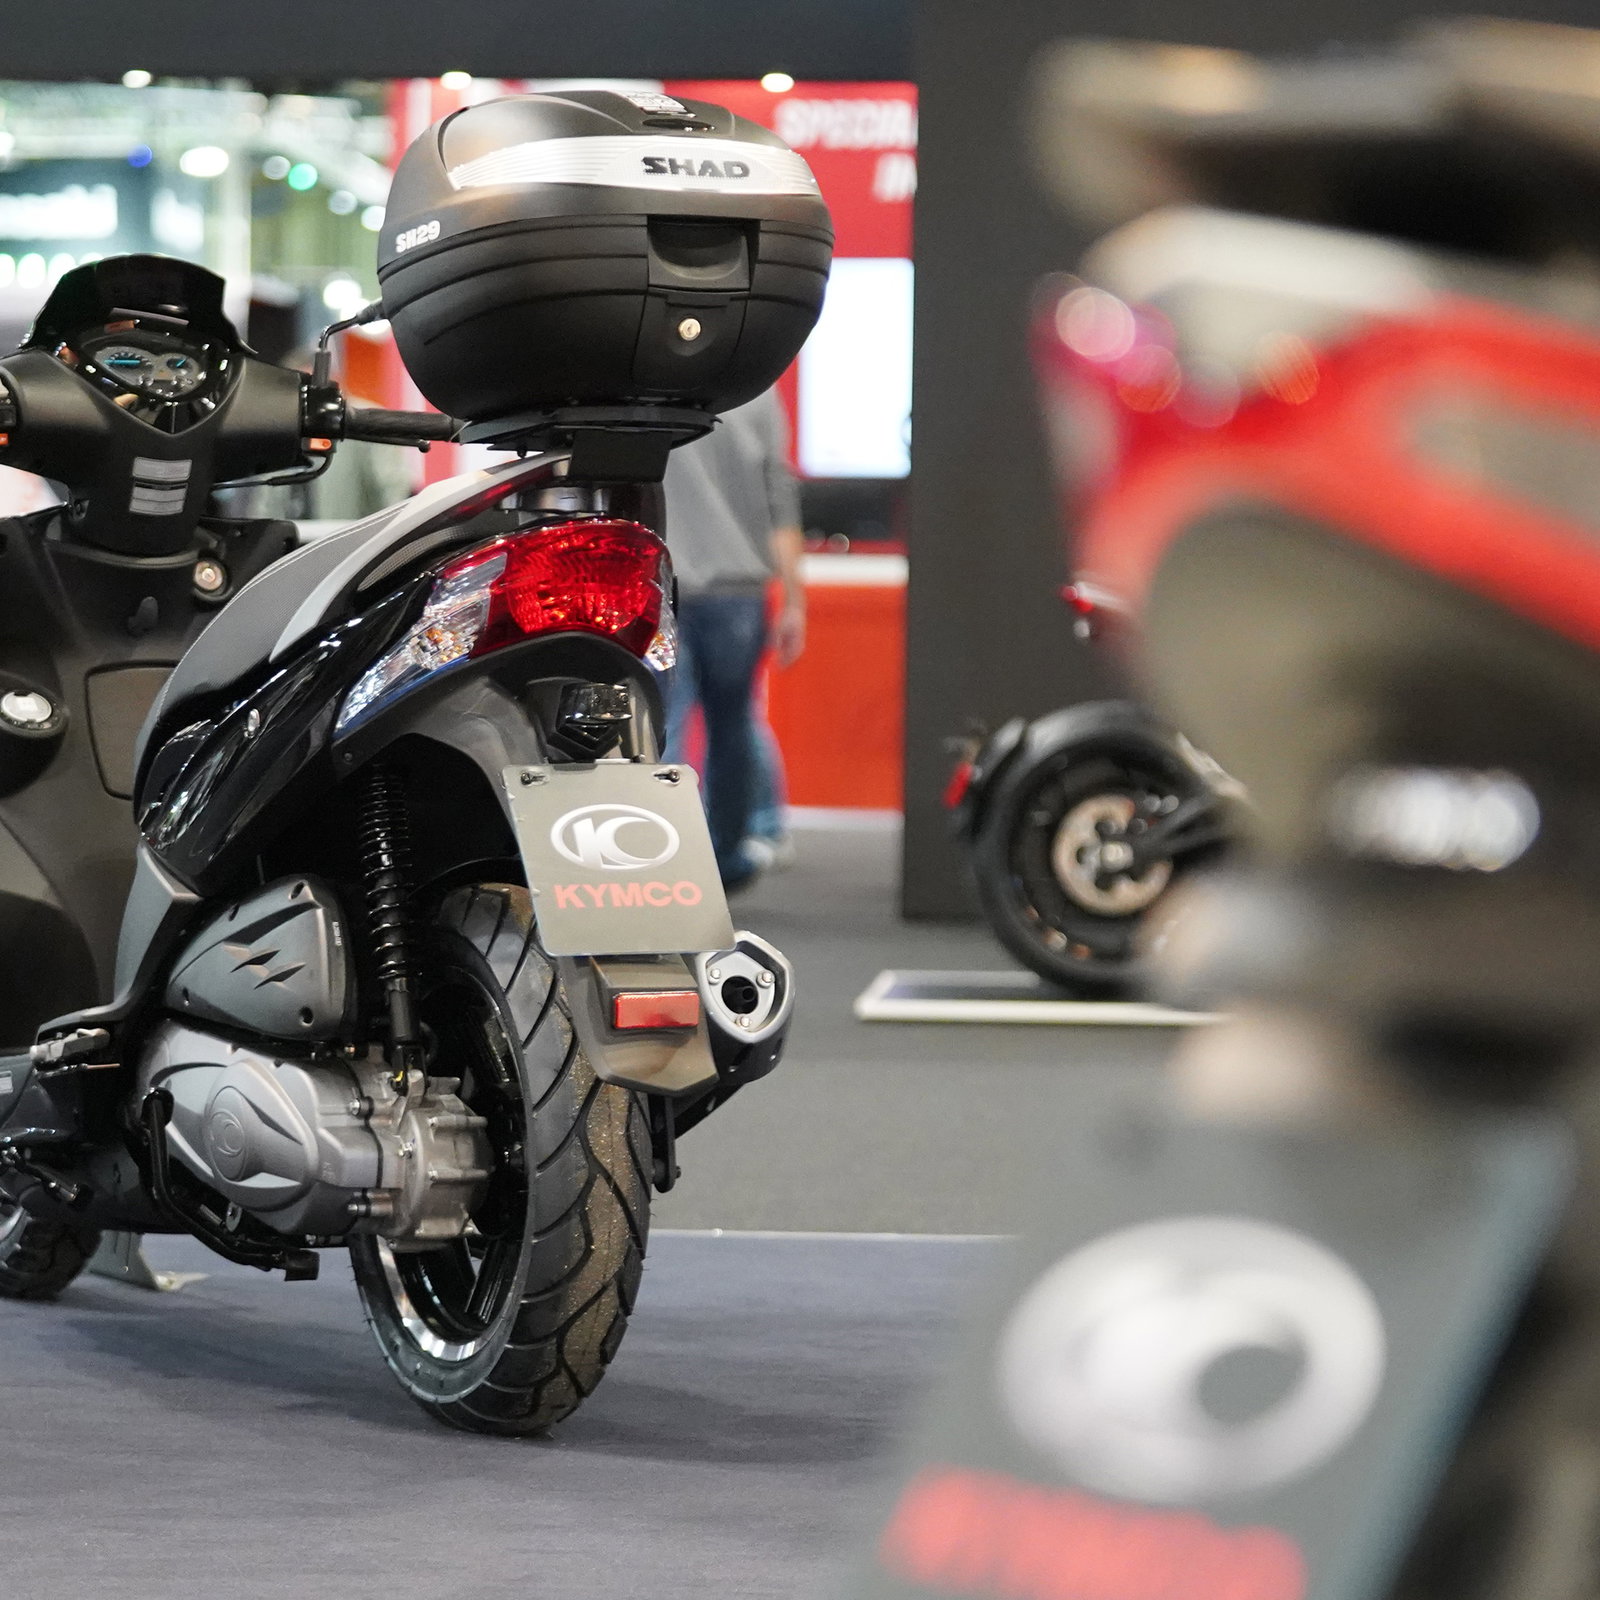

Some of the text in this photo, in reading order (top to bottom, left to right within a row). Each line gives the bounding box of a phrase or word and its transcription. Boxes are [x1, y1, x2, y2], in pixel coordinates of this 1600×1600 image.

[641, 156, 750, 178] SHAD
[396, 220, 440, 253] SH29
[554, 881, 702, 909] KYMCO
